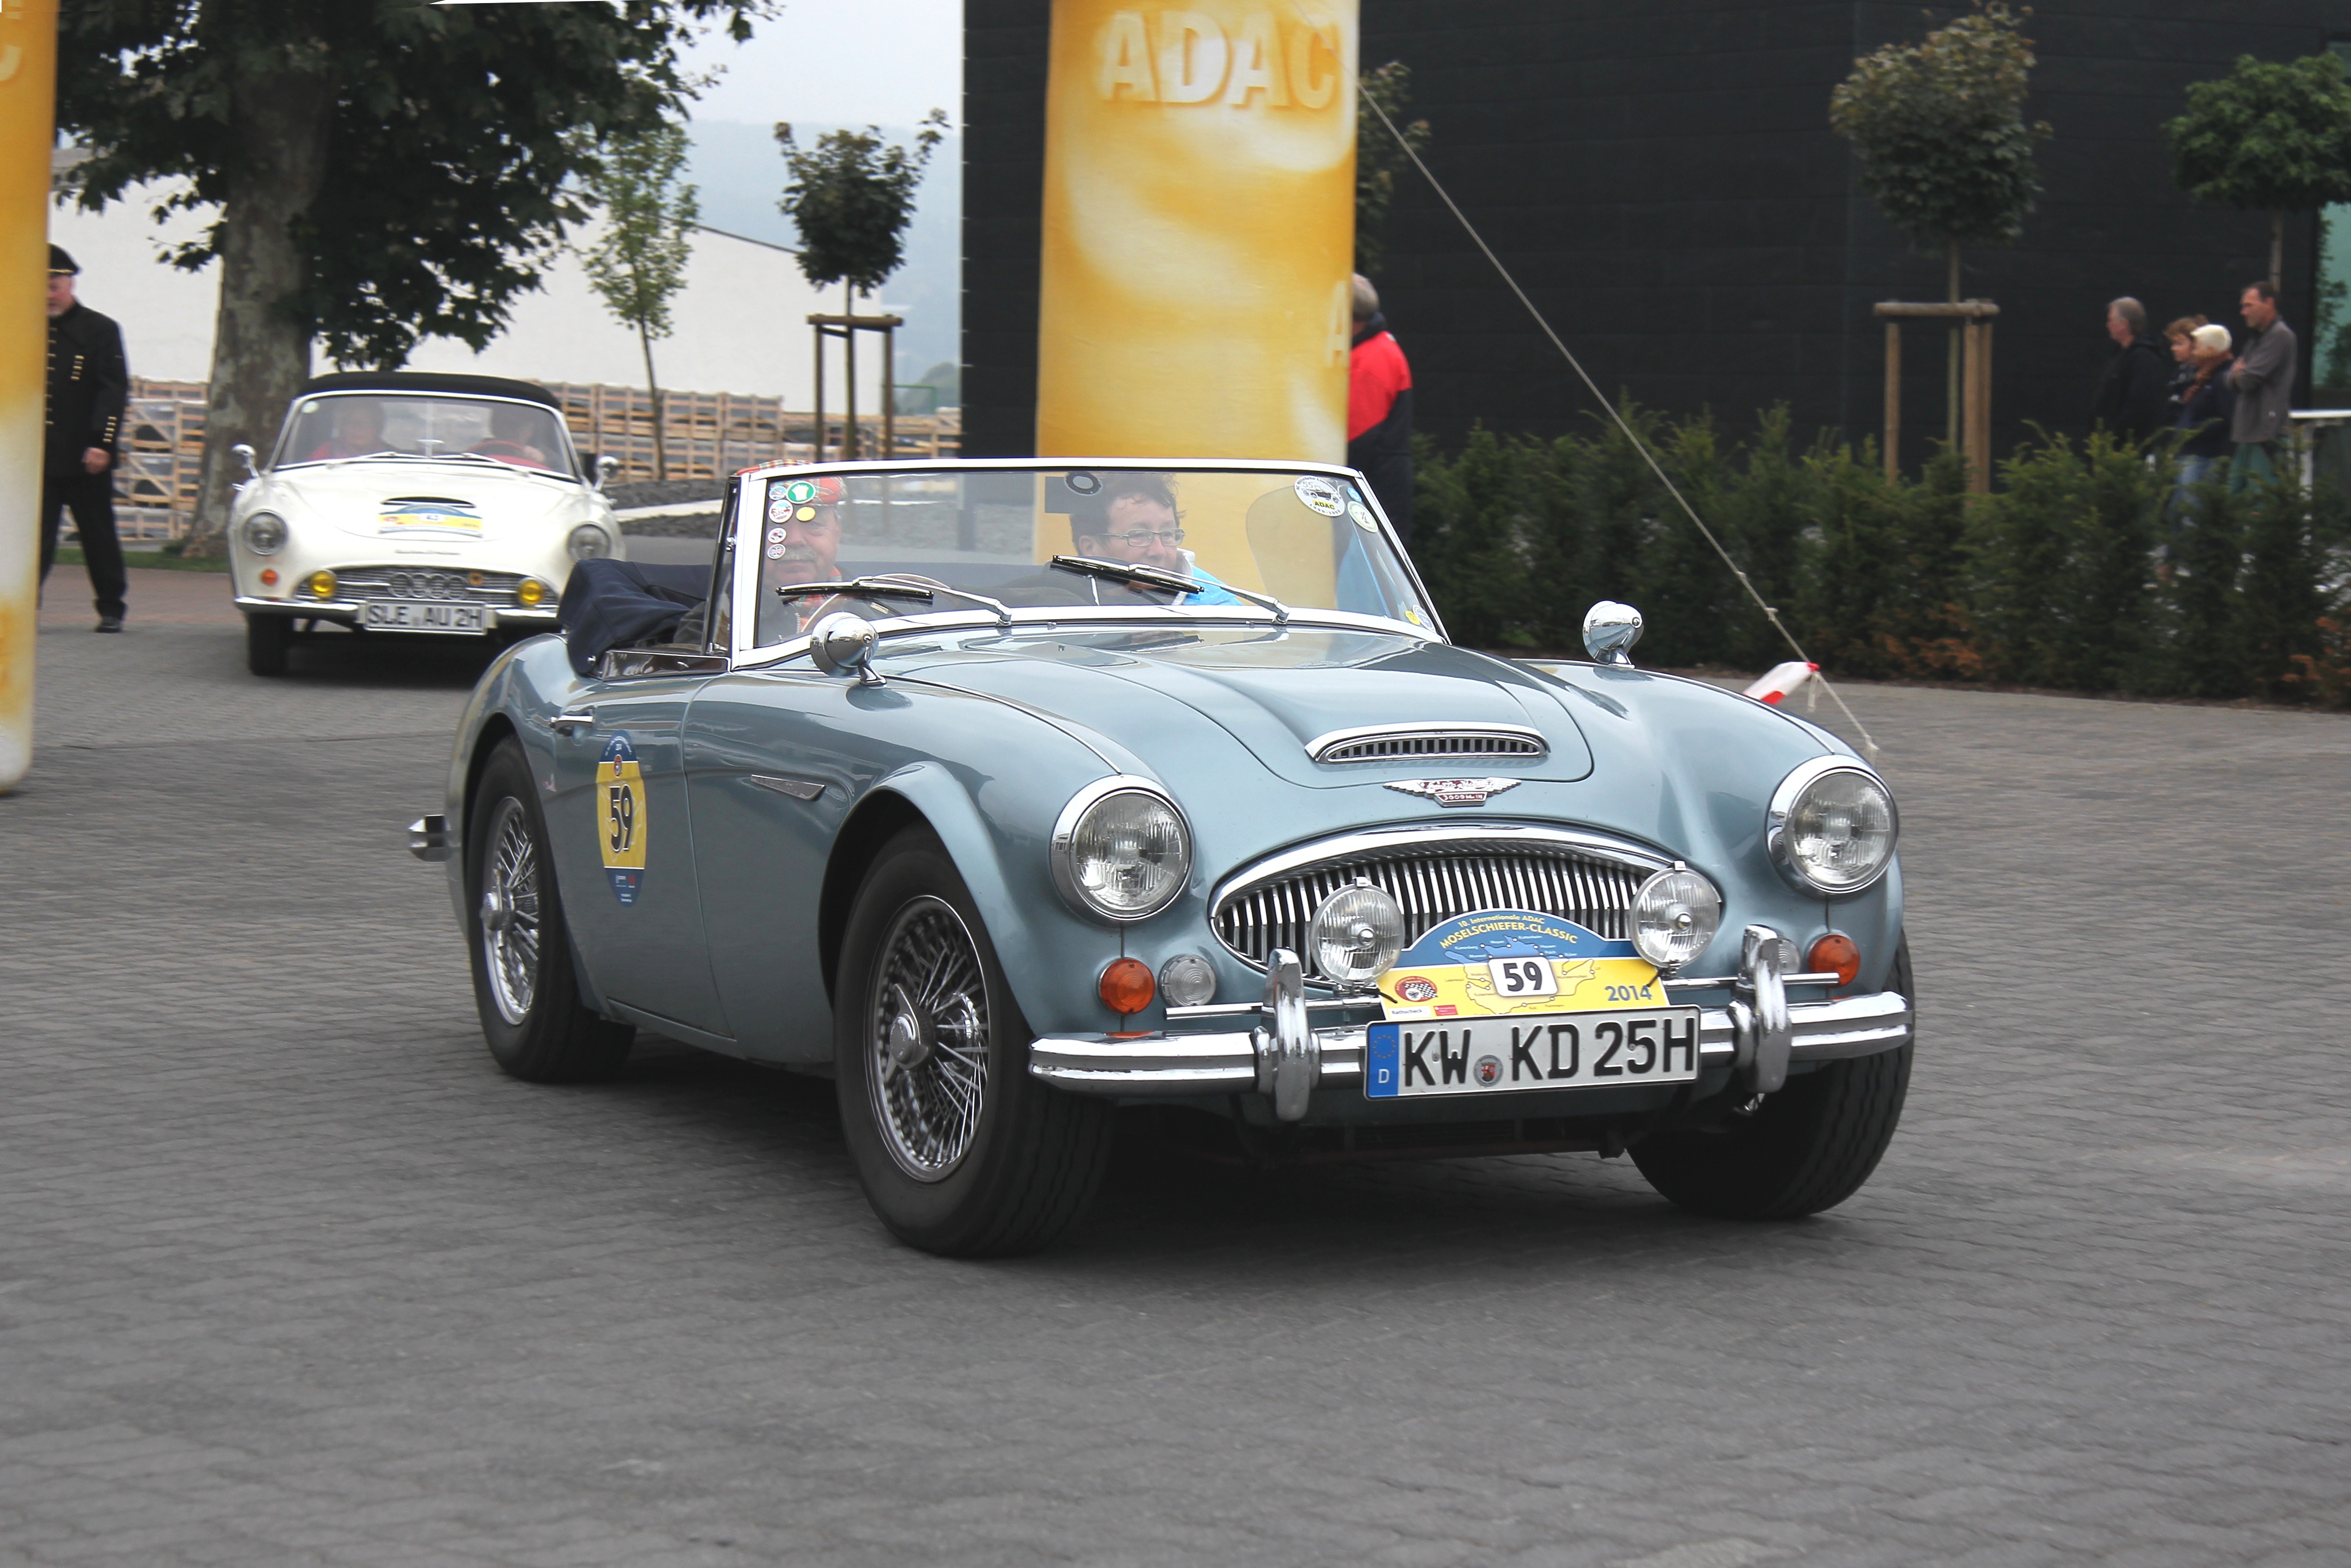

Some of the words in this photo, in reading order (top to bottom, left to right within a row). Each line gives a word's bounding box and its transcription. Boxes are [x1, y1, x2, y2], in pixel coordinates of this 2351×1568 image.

[1097, 9, 1341, 109] ADAC
[1314, 501, 1335, 510] ADAC
[369, 605, 408, 624] SLE
[423, 607, 451, 626] AU
[455, 608, 482, 627] 2H
[609, 784, 633, 853] 59
[1472, 914, 1521, 924] Internationale
[1522, 915, 1545, 924] ADAC
[1439, 922, 1578, 949] MOSELSCHIEFER-CLASSIC
[1503, 962, 1543, 992] 59
[1605, 985, 1652, 1001] 2014
[1405, 1029, 1471, 1087] KW
[1512, 1023, 1580, 1081] KD
[1594, 1017, 1694, 1077] 25H
[1379, 1069, 1389, 1084] D
